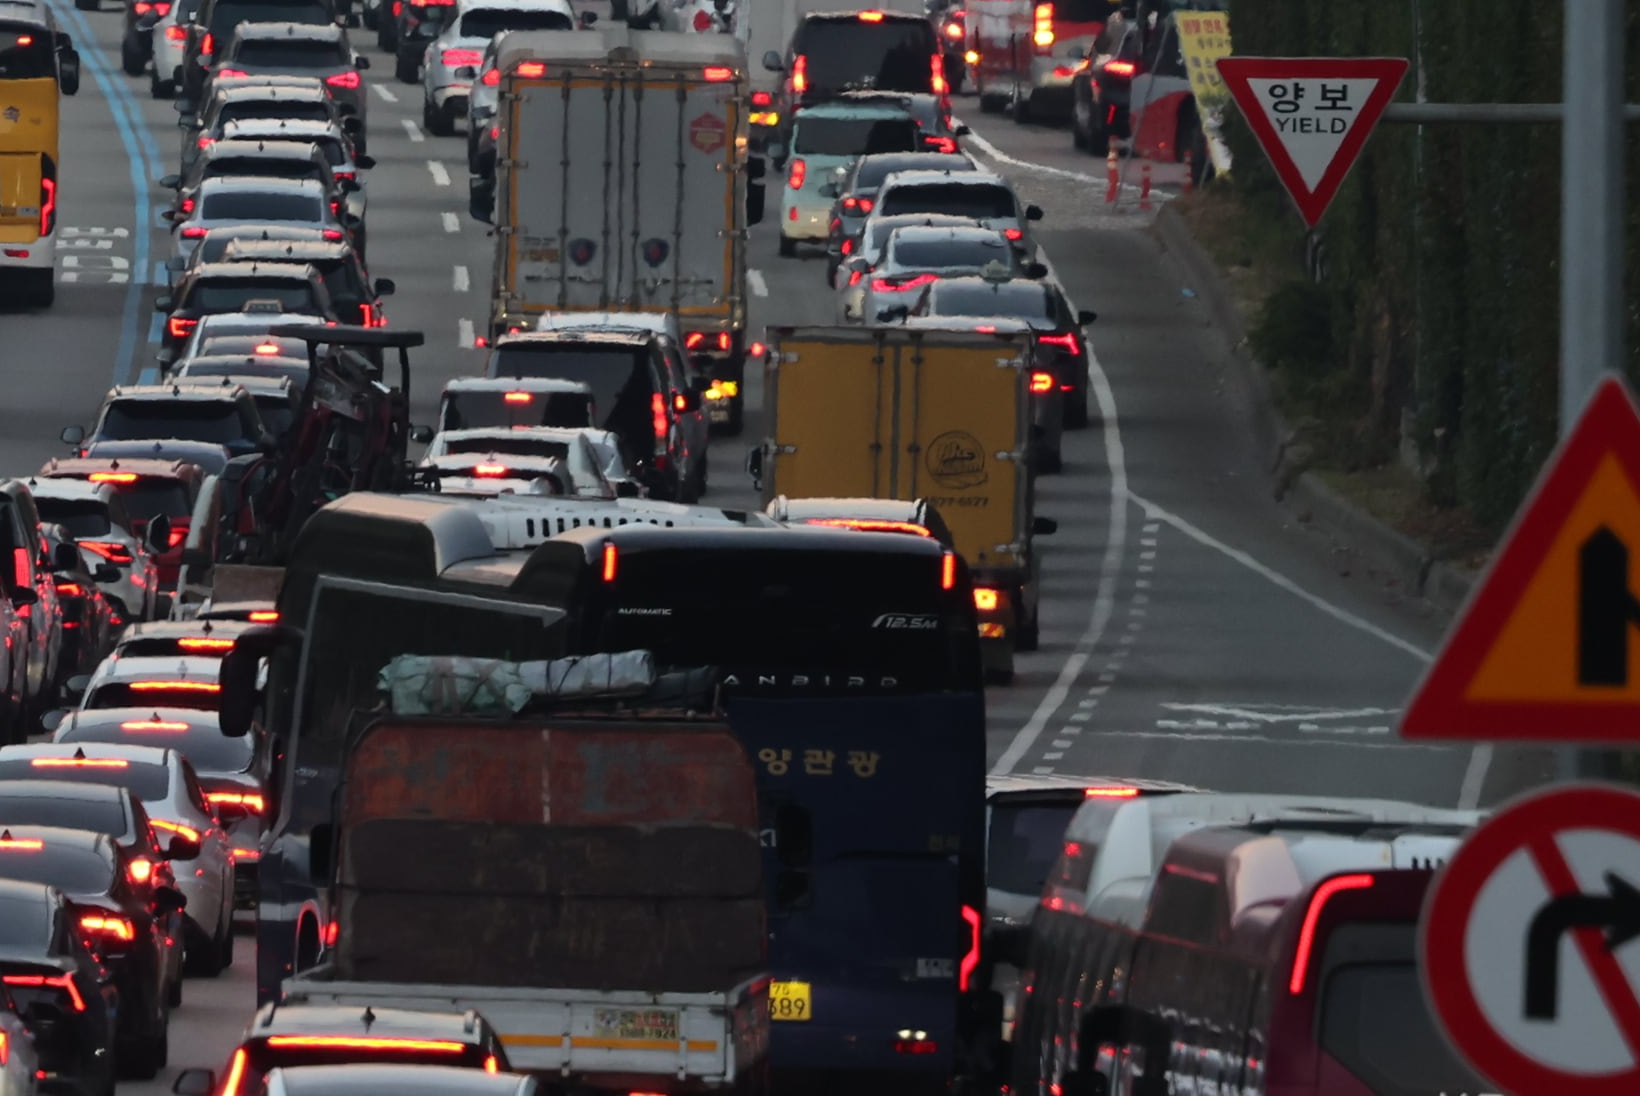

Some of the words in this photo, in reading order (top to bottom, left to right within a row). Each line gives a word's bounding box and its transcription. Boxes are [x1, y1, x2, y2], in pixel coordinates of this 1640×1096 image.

[1268, 82, 1353, 114] 양보
[1275, 117, 1347, 135] YIELD
[617, 607, 673, 616] AUTOMATIC
